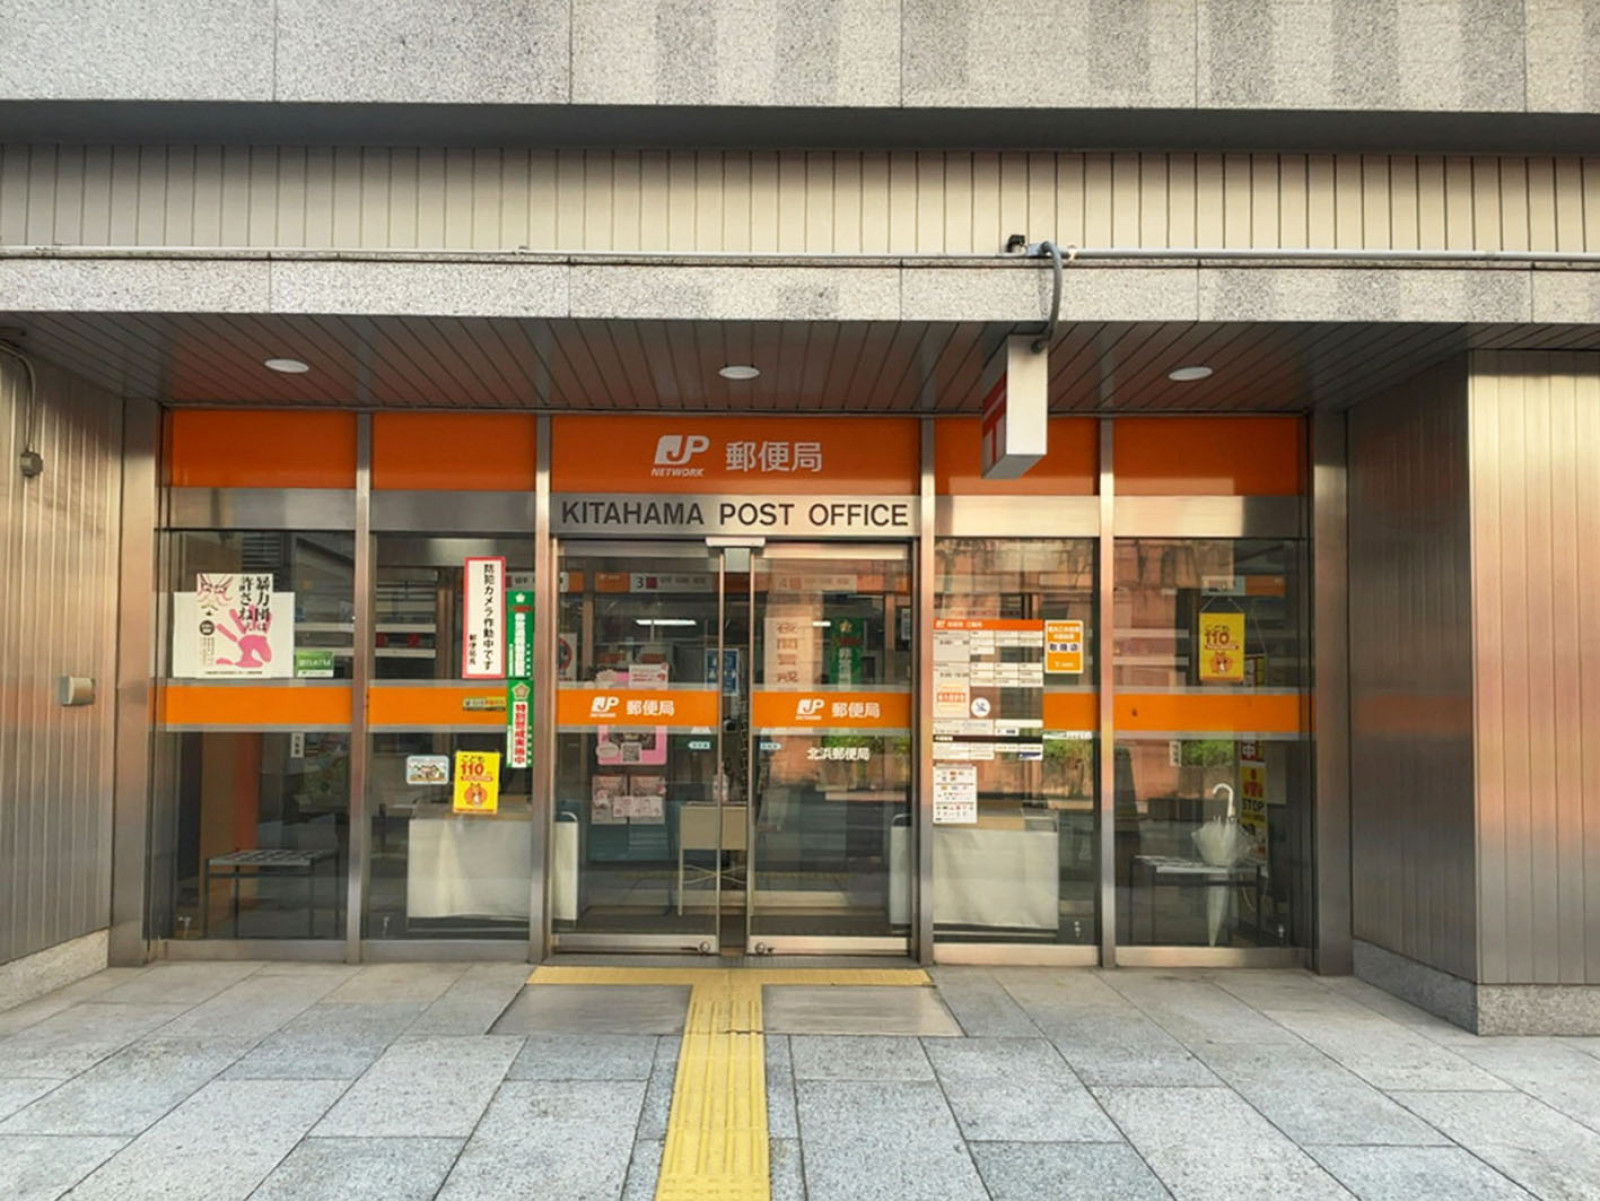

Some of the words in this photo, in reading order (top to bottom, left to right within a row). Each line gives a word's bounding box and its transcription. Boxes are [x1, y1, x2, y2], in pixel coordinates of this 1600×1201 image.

[725, 441, 823, 473] 郵便局
[651, 468, 705, 477] NETWORK
[562, 501, 705, 525] KITAHAMA
[719, 503, 795, 526] POST
[809, 503, 908, 527] OFFICE
[626, 700, 675, 717] 郵便局
[831, 702, 881, 719] 郵便局
[460, 763, 484, 775] 110
